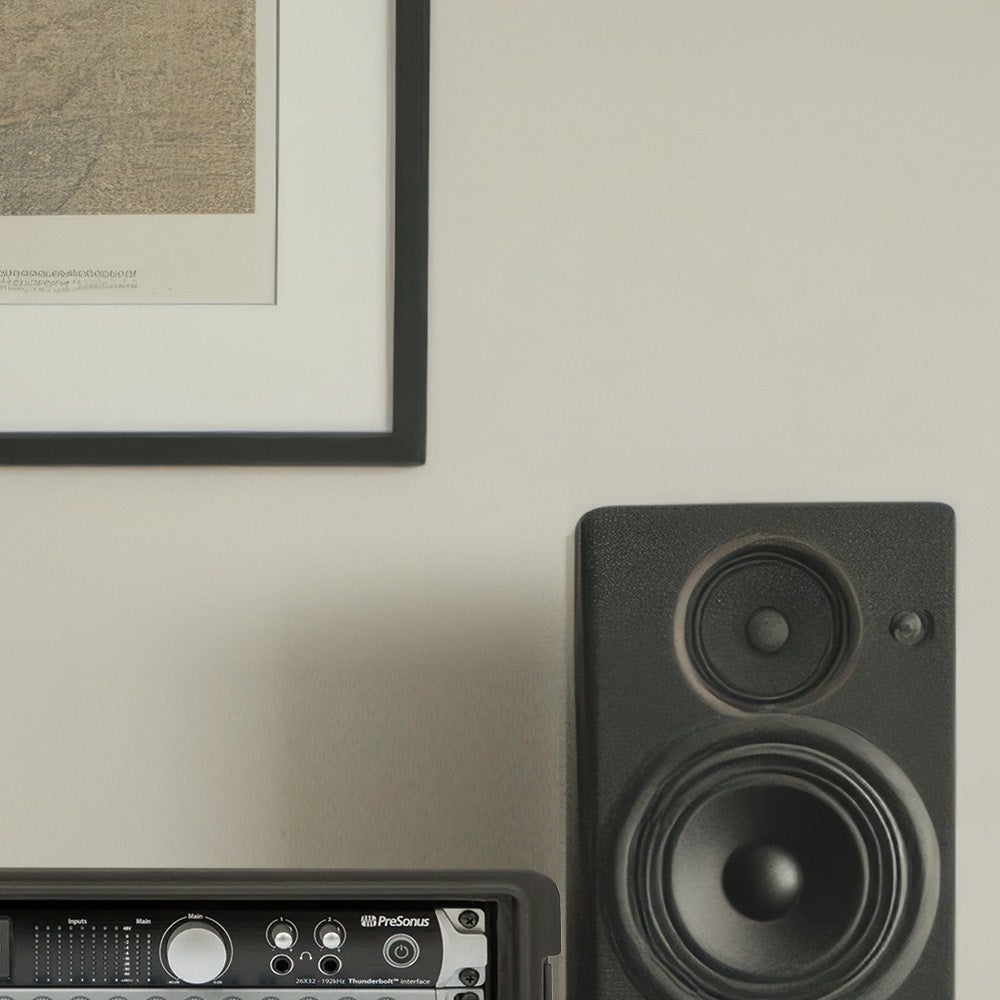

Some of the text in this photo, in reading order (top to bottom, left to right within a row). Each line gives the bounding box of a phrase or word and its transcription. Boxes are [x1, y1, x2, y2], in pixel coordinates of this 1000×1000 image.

[187, 912, 204, 920] Main
[67, 917, 88, 926] Inputs
[135, 917, 152, 925] Main
[377, 915, 431, 928] PreSonus
[321, 977, 346, 985] 192kHz
[400, 977, 431, 985] interface
